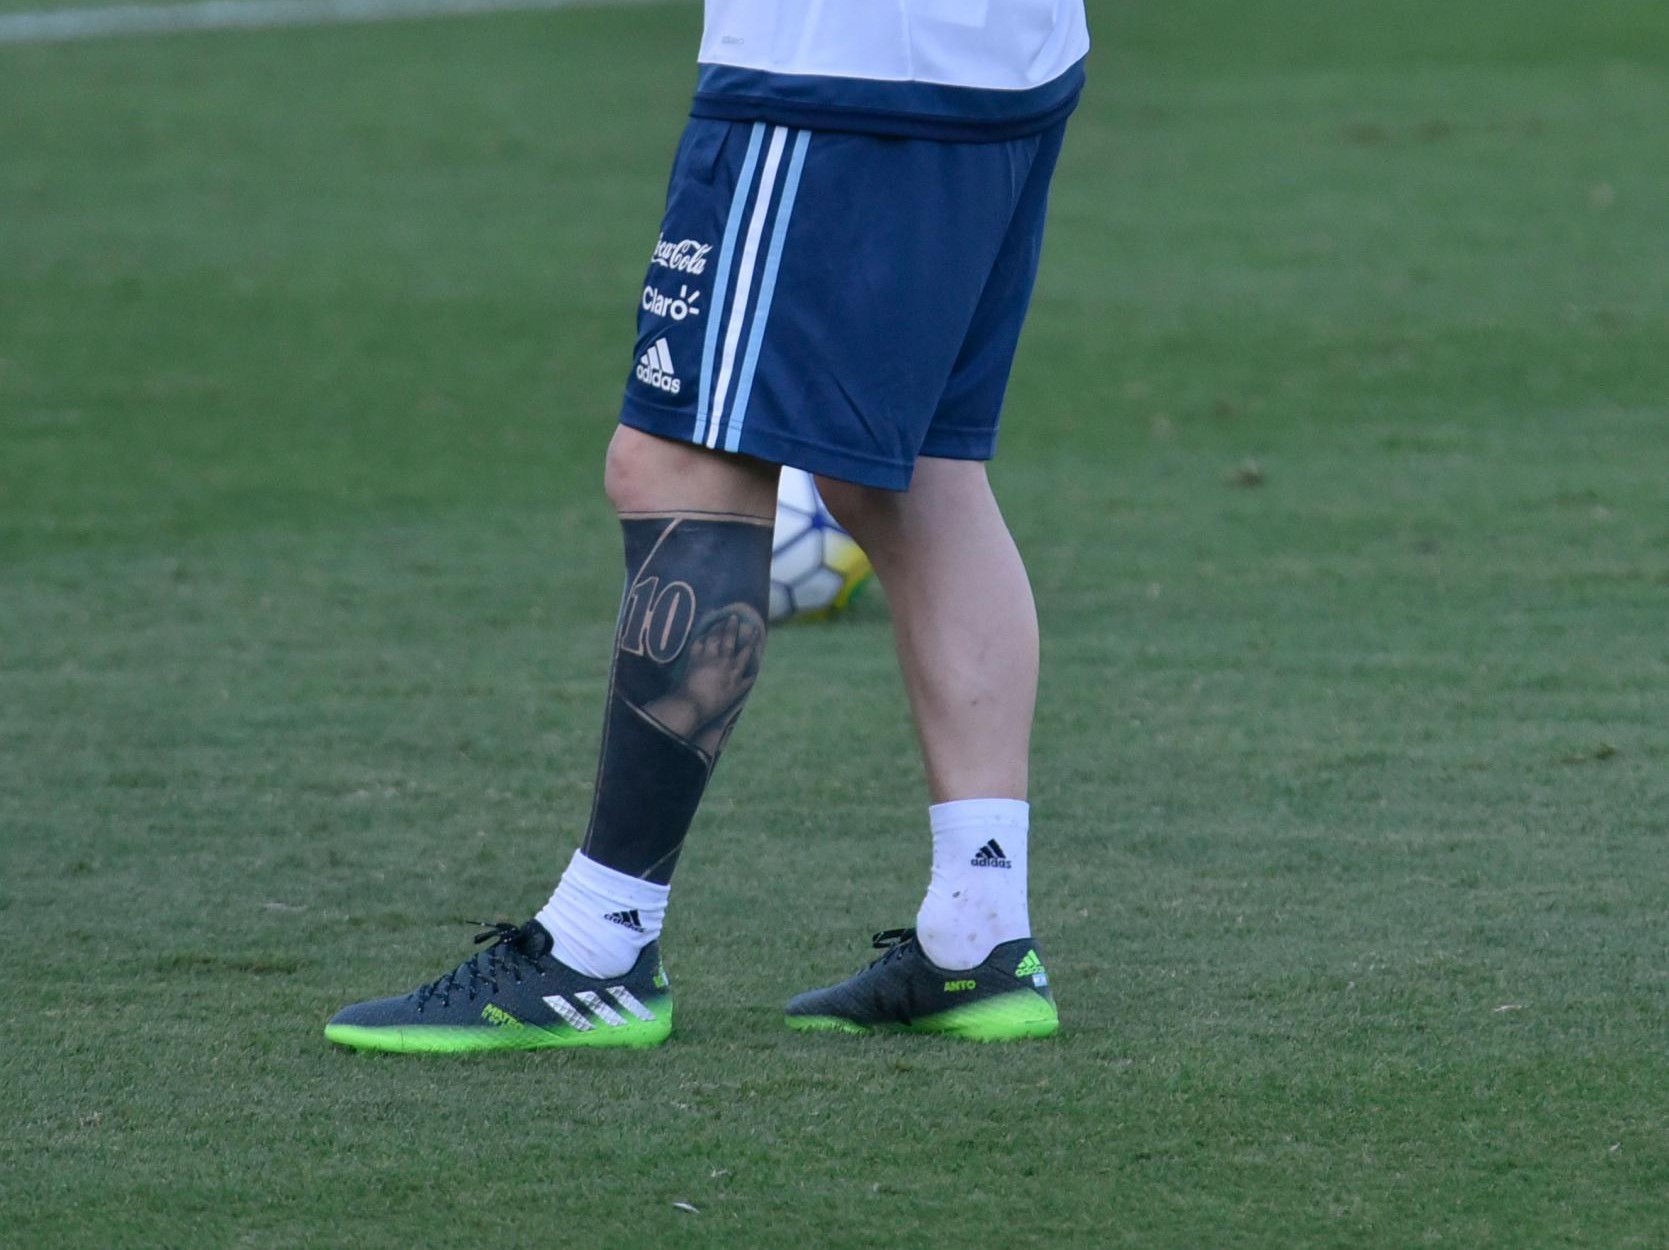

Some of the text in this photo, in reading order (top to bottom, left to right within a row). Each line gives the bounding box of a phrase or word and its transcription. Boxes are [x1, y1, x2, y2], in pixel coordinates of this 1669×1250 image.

[642, 285, 688, 320] Claro
[636, 363, 681, 394] adidas
[620, 576, 697, 664] 10
[971, 857, 1012, 869] adidas
[944, 979, 977, 992] ANTO
